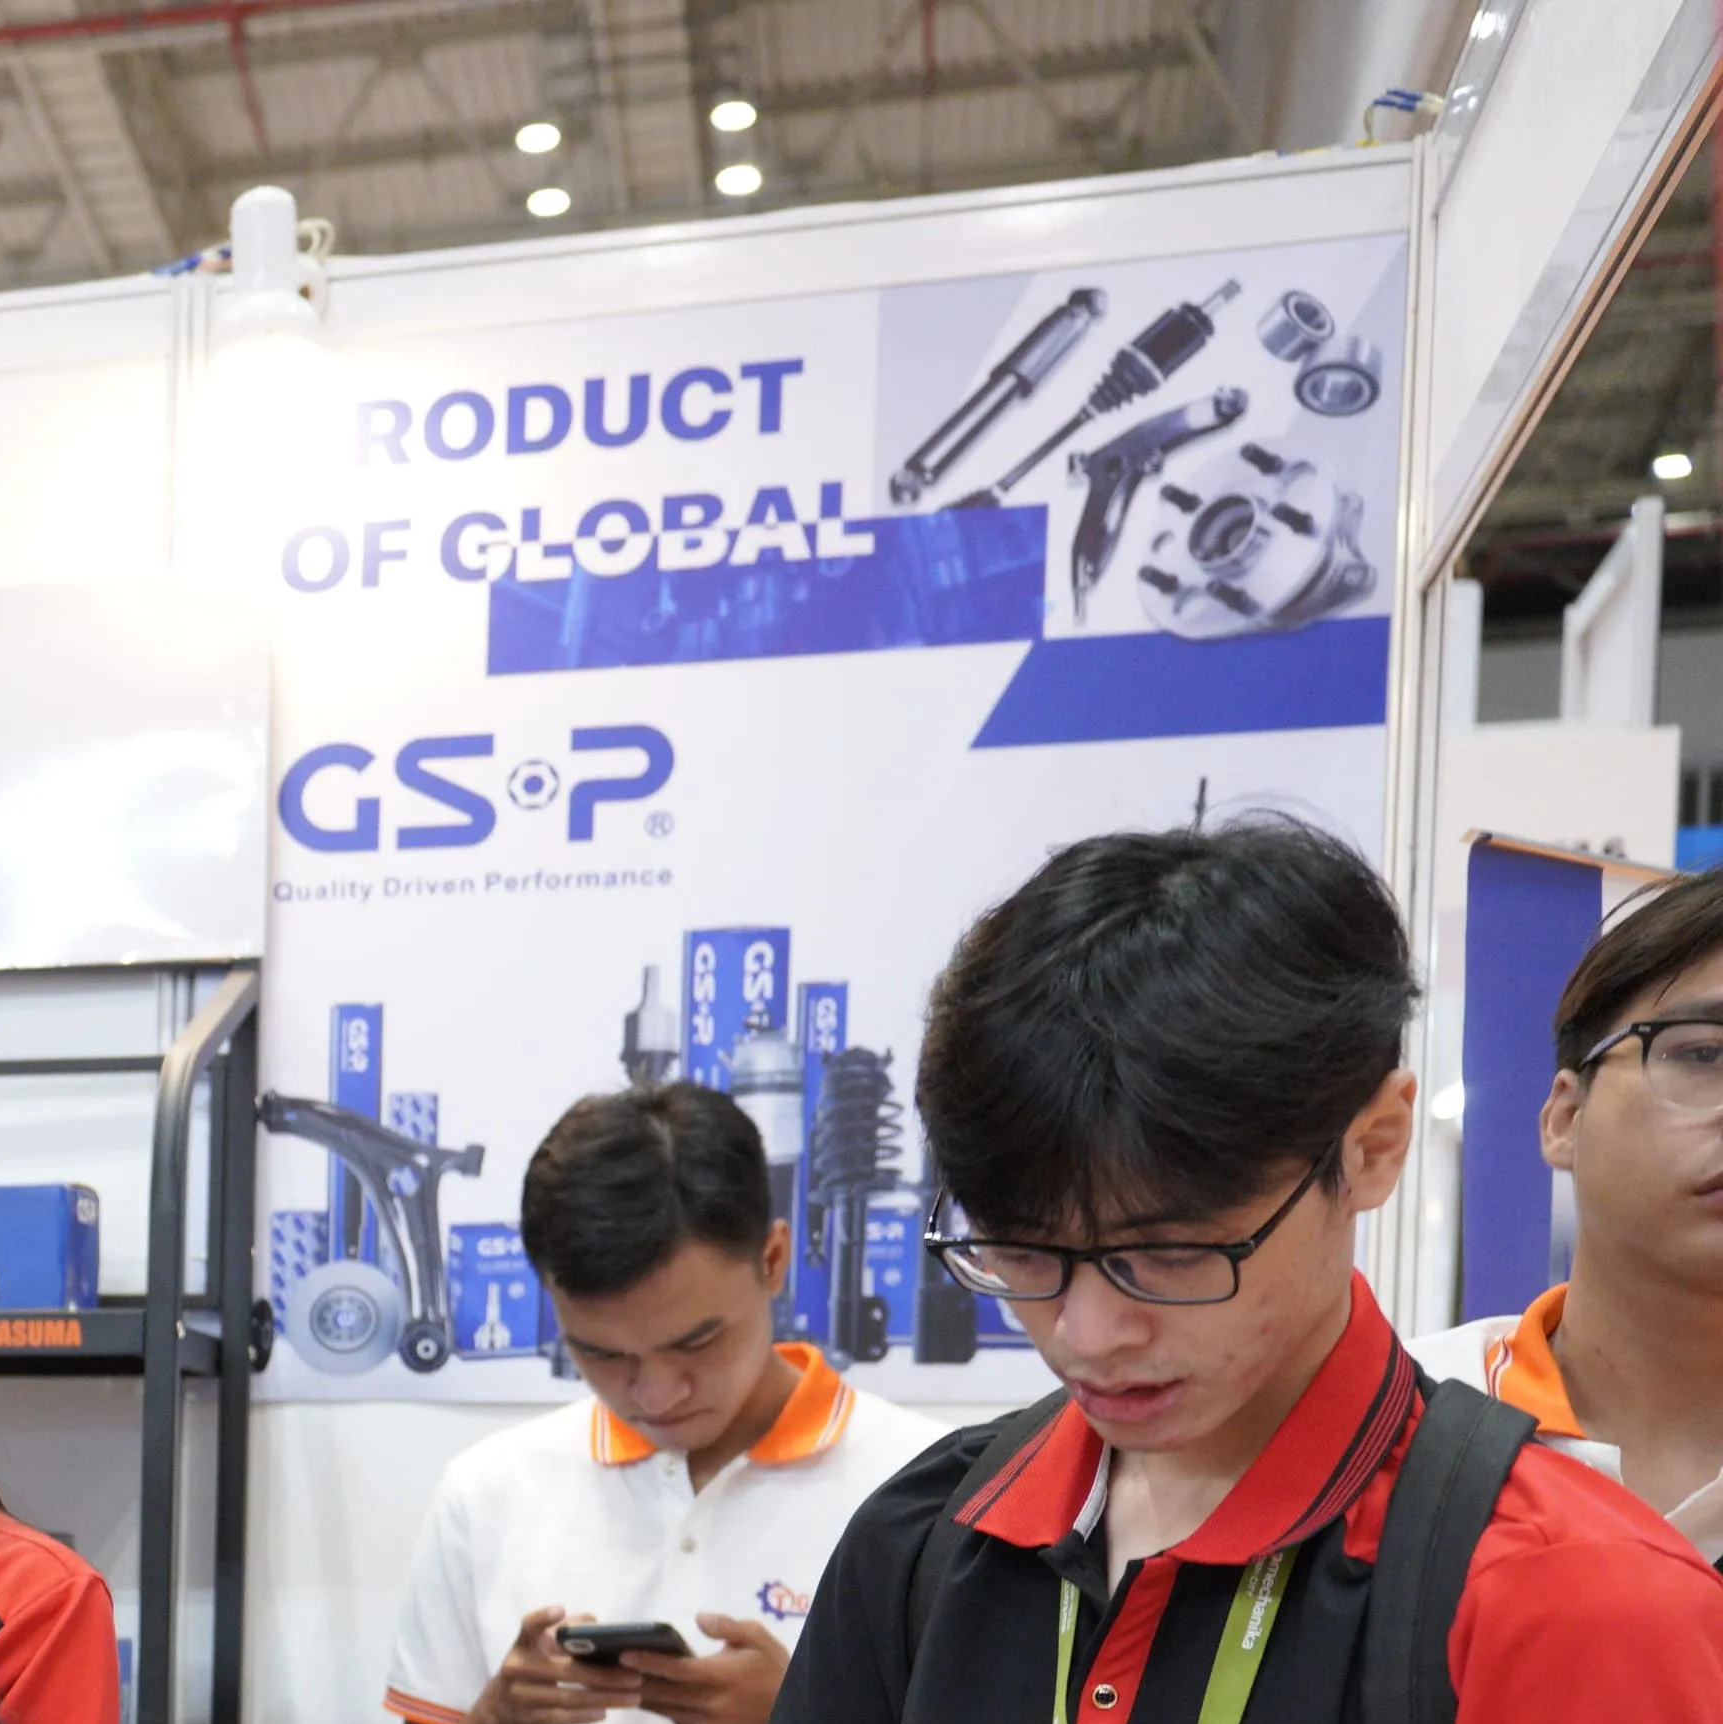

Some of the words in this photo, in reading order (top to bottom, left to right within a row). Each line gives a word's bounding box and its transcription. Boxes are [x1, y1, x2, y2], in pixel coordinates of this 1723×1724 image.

[281, 519, 410, 594] OF
[439, 481, 875, 584] GLOBAL
[278, 724, 676, 853] GSP
[272, 877, 374, 903] Quality
[383, 873, 476, 899] Driven
[484, 867, 674, 894] Performance
